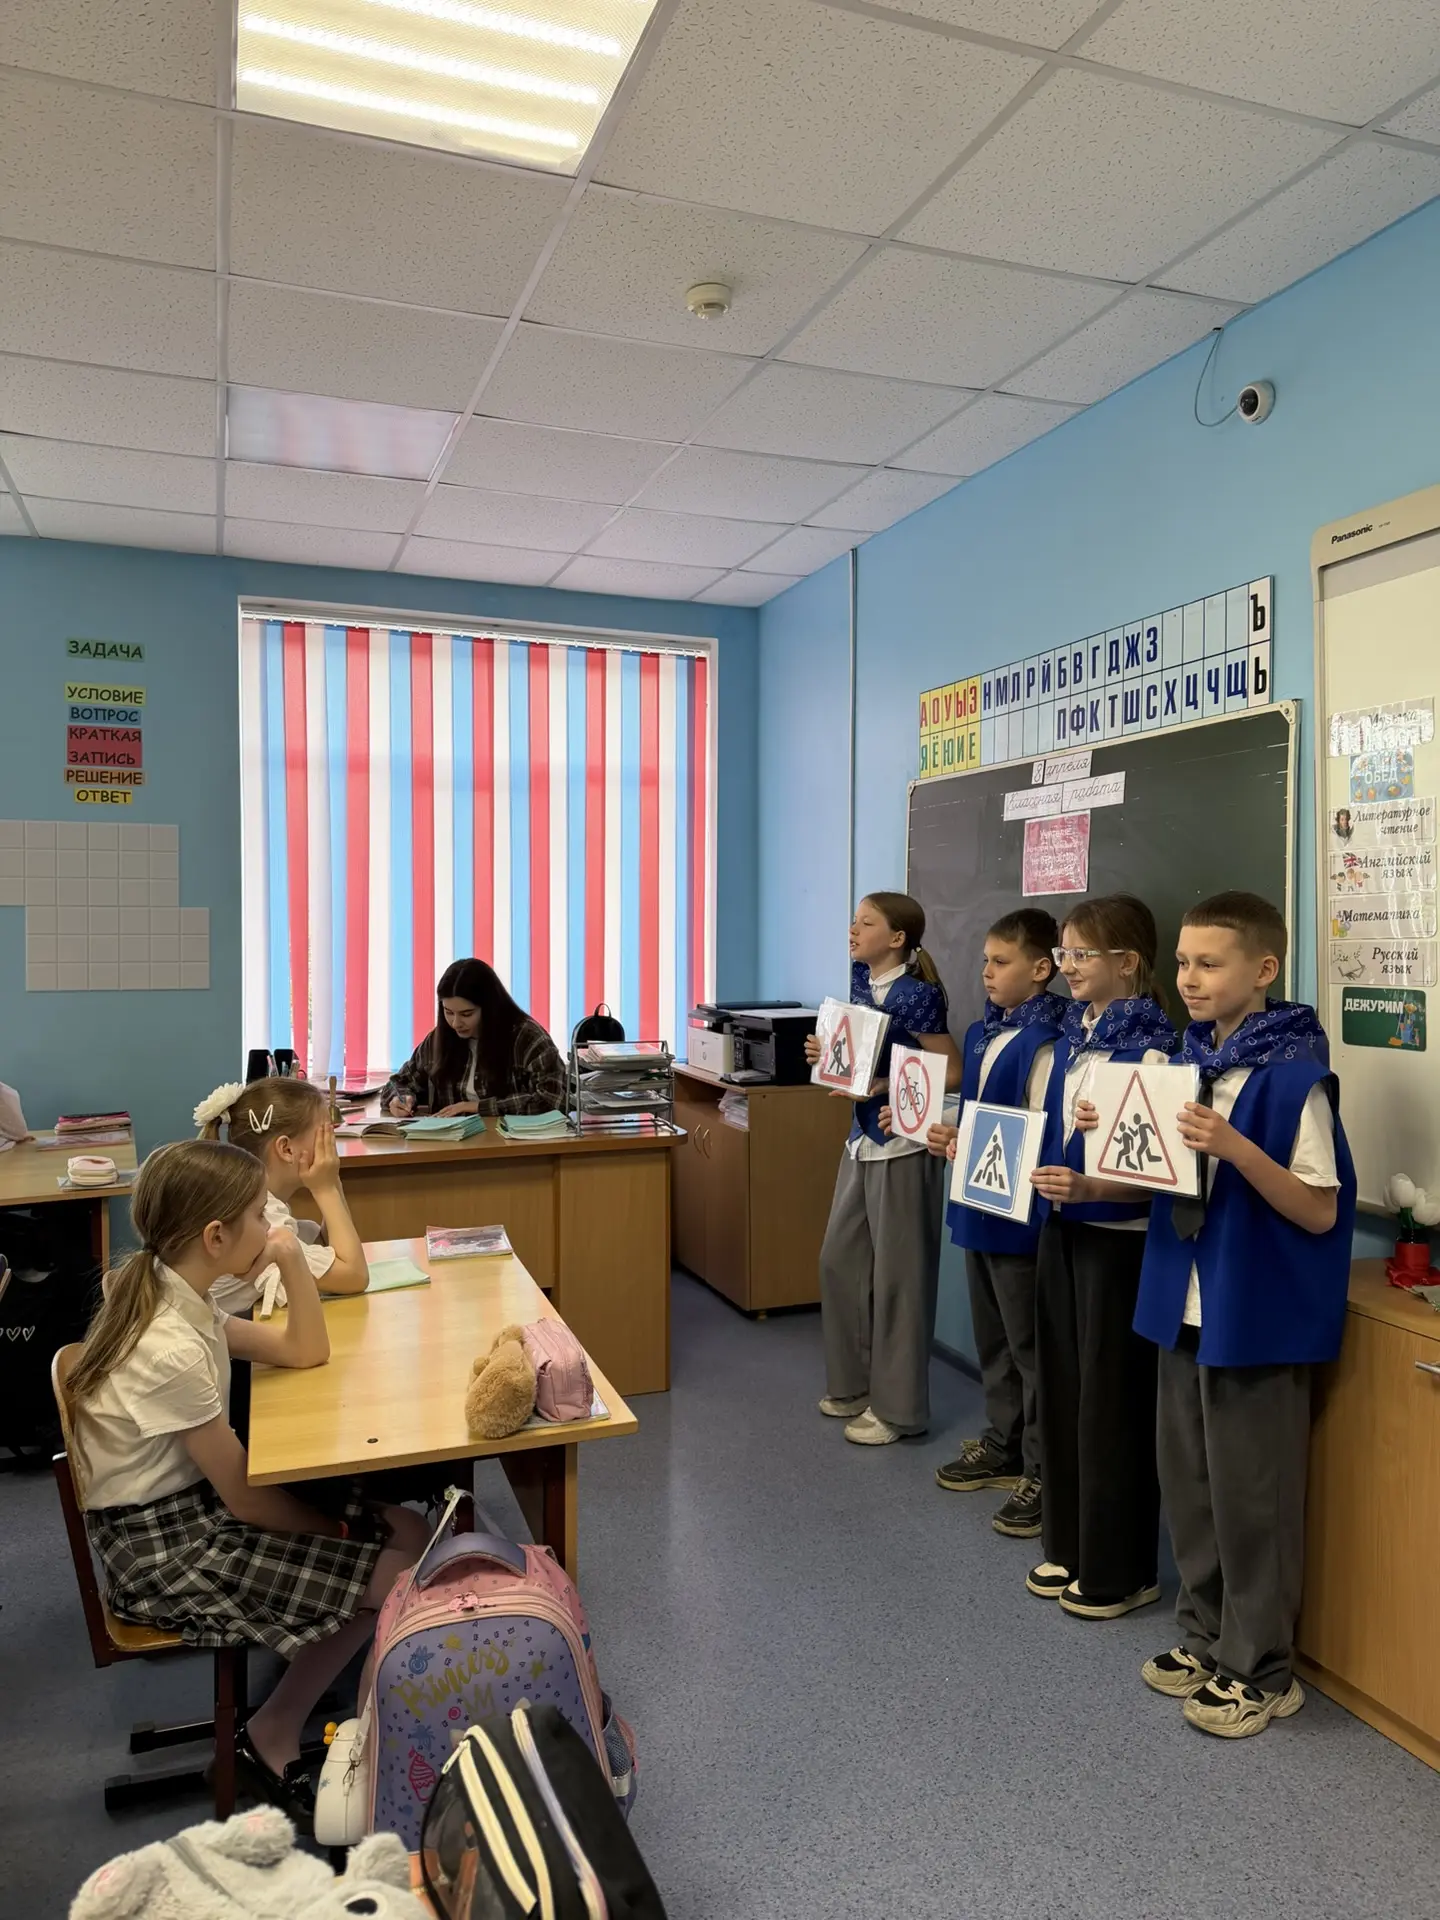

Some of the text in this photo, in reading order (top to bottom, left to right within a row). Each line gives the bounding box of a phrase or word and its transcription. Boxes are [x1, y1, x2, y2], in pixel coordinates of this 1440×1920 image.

[1331, 524, 1373, 544] Panasonic
[68, 640, 143, 659] ЗАДАЧА
[67, 686, 144, 704] УСЛОВИЕ
[70, 707, 139, 722] ВОПРОС
[69, 728, 142, 742] КРАТКАЯ
[69, 751, 135, 765] ЗАПИСЬ
[66, 770, 143, 785] РЕШЕНИЕ
[1045, 757, 1091, 781] апреля
[1365, 767, 1398, 784] ОБЕД
[76, 790, 131, 803] ОТВЕТ
[1068, 778, 1121, 808] работа
[1382, 868, 1413, 879] язык
[1337, 909, 1420, 922] Математика
[1372, 947, 1418, 964] Русский
[1381, 964, 1412, 974] язык
[1344, 997, 1403, 1014] ДЕЖУРИМ
[394, 1641, 510, 1719] Princess
